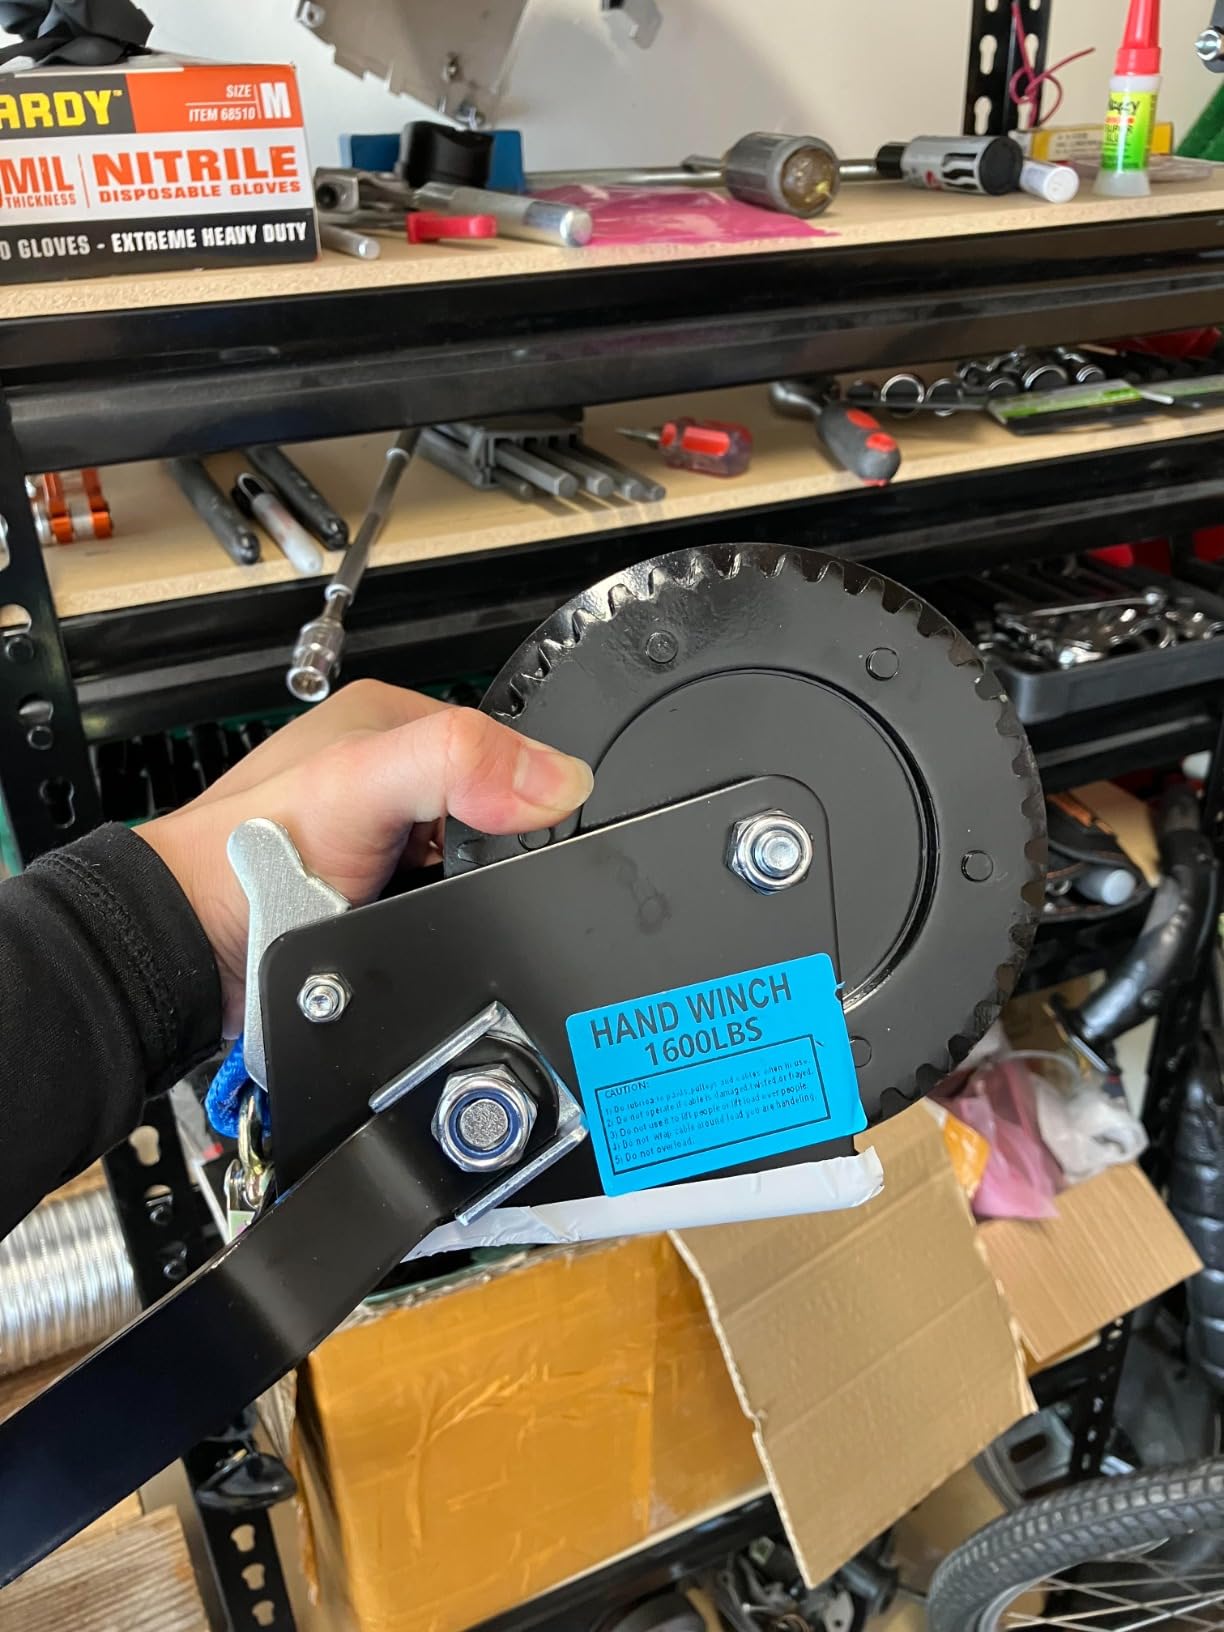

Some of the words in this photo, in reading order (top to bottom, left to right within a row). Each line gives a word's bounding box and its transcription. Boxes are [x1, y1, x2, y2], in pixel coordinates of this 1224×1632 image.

[226, 83, 252, 98] SIZE
[259, 82, 292, 119] M
[189, 108, 217, 122] ITEM
[220, 106, 256, 121] 68510
[92, 145, 298, 187] NITRILE
[5, 193, 77, 209] THICKNESS
[99, 184, 222, 203] DISPOSABLE
[230, 180, 301, 196] GLOVES
[18, 234, 91, 259] GLOVES
[111, 228, 197, 253] EXTREME
[201, 225, 257, 247] HEAVY
[262, 221, 307, 243] DUTY
[590, 1001, 679, 1049] HAND
[685, 972, 792, 1024] WINCH
[644, 1016, 763, 1066] 1600LBS
[605, 1082, 650, 1097] CAUTION:
[640, 1147, 654, 1158] not
